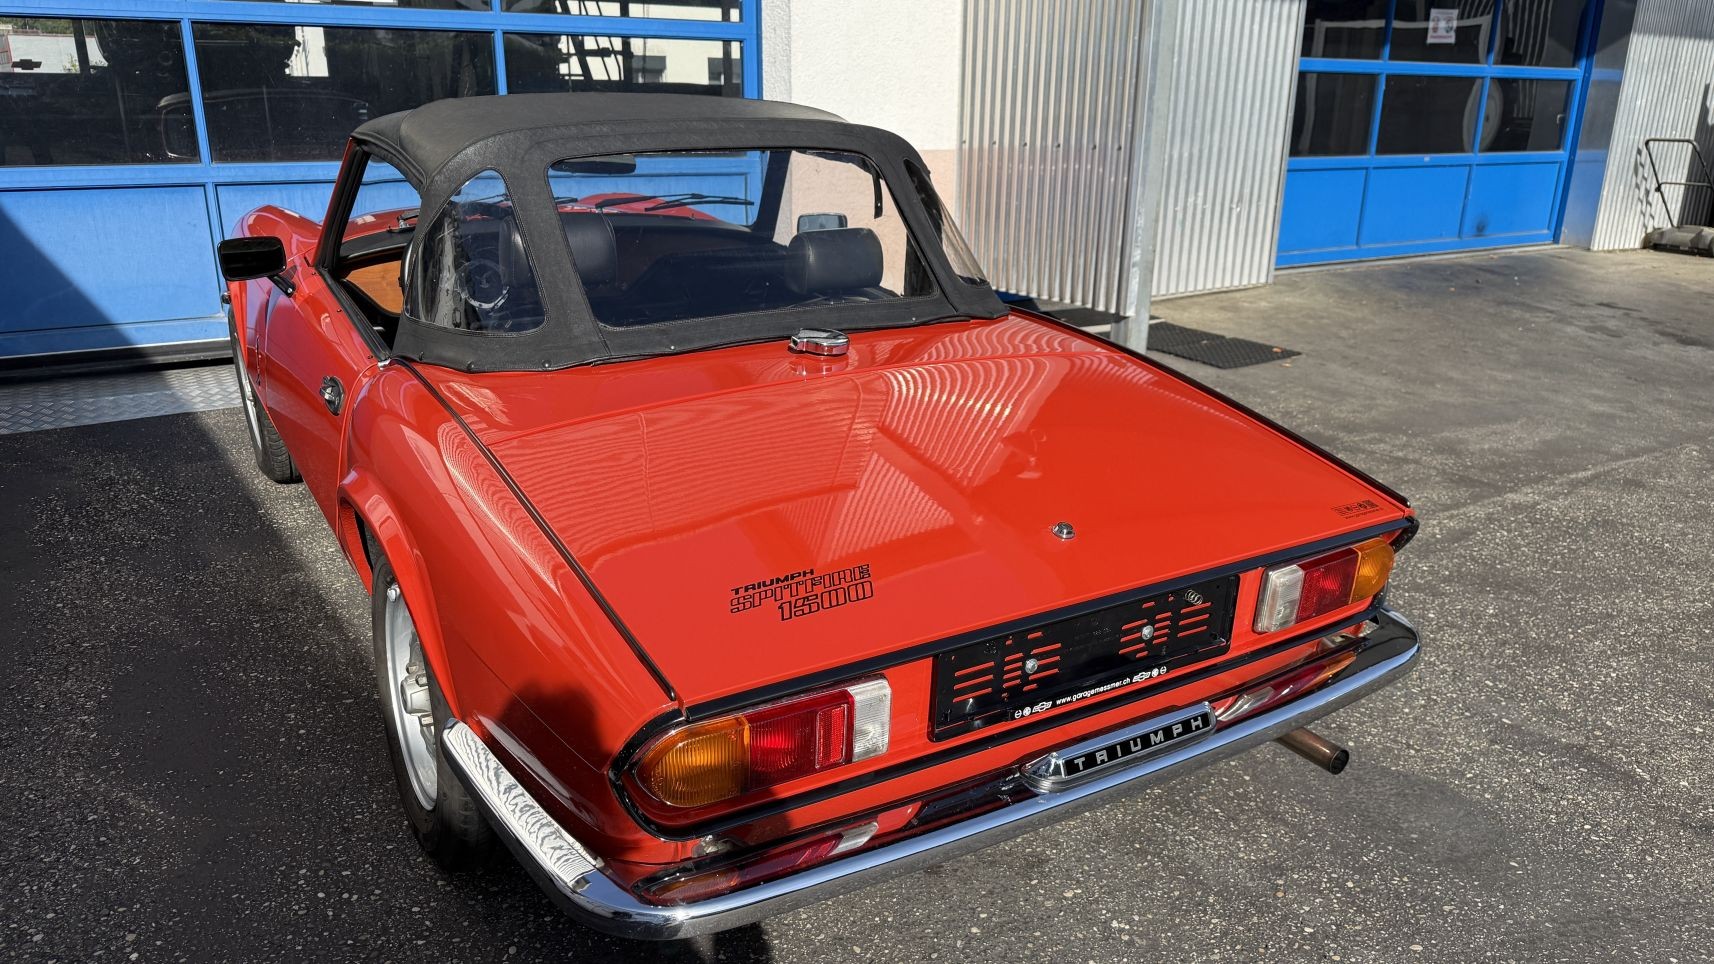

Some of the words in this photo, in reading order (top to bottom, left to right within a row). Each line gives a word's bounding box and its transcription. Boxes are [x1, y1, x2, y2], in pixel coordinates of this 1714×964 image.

[730, 564, 871, 613] SPITFIRE
[731, 569, 814, 595] TRIUMPH
[778, 580, 874, 621] 1500
[1056, 678, 1131, 705] www.garagemessmer.ch
[1074, 716, 1203, 770] TRIUMPH
